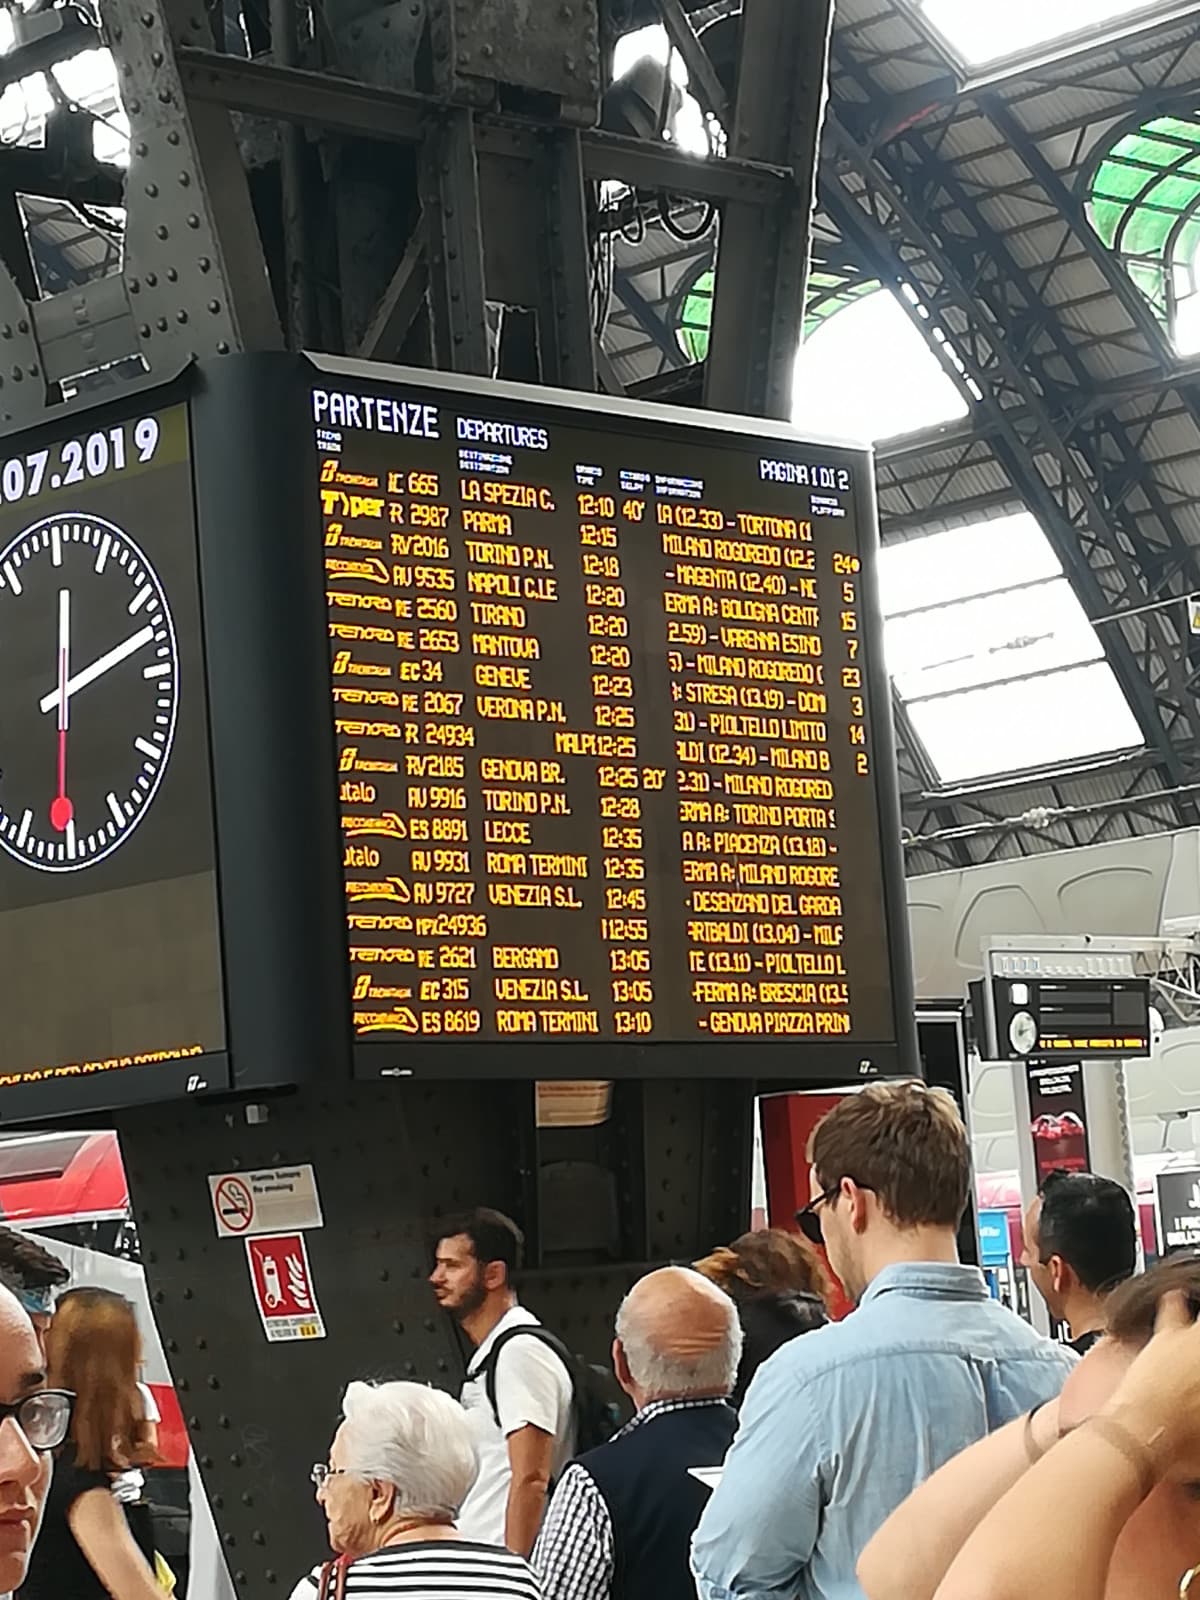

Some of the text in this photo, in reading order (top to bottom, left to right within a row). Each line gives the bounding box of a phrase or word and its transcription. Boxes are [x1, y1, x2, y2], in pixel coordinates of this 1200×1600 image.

[313, 390, 547, 449] PARTENZE DEPARTURES
[760, 460, 849, 489] PAGINA 1 DI 2
[408, 472, 438, 495] 665
[461, 480, 480, 501] LA
[483, 482, 537, 507] SPEZIA
[539, 489, 554, 510] C.
[578, 494, 614, 517] 12:10
[675, 506, 723, 530] (12.33)
[737, 514, 797, 539] TORTONA
[389, 503, 404, 523] R
[410, 504, 449, 527] 2987
[462, 510, 512, 535] PARMA
[580, 525, 616, 547] 12:15
[663, 534, 712, 558] MILANO
[714, 540, 781, 566] ROGOREDO
[465, 541, 520, 566] TORINO
[523, 547, 553, 569] P.N.
[583, 555, 619, 577] 12:18
[677, 564, 737, 590] MAGENTA
[740, 572, 786, 595] (12.40)
[844, 582, 854, 602] 5
[393, 565, 412, 587] AV
[415, 566, 454, 590] 9535
[468, 571, 521, 596] NAPOLI
[586, 584, 625, 607] 12:20
[720, 598, 780, 623] BOLOGNA
[841, 611, 856, 630] 15
[416, 598, 457, 621] 2560
[470, 602, 525, 628] TIRANO
[588, 615, 627, 636] 12:20
[721, 627, 780, 651] VARENNA
[782, 633, 821, 656] ESINO
[847, 640, 857, 659] 7
[419, 629, 459, 652] 2653
[472, 634, 539, 659] MANTOVA
[591, 644, 630, 667] 12:20
[697, 654, 746, 678] MILANO
[748, 658, 814, 684] ROGOREDO
[842, 668, 861, 687] 23
[475, 665, 531, 689] GENEVE
[592, 675, 632, 697] 12:23
[686, 683, 738, 706] STRESA
[740, 686, 784, 709] (13.19)
[852, 697, 863, 715] 3
[424, 691, 463, 715] 2067
[477, 696, 534, 720] VERONA
[537, 700, 566, 723] P.N.
[595, 705, 634, 727] 12:25
[709, 714, 779, 738] PIOLTELLO
[781, 719, 826, 741] LIMITO
[850, 725, 864, 744] 14
[405, 723, 419, 743] R
[425, 723, 474, 746] 24934
[595, 736, 636, 757] 12:25
[709, 744, 756, 766] (12.34)
[770, 747, 817, 769] MILANO
[857, 753, 868, 773] 2
[481, 759, 538, 782] GENOVA
[541, 762, 565, 783] BR.
[598, 766, 638, 788] 12:25
[725, 773, 772, 796] MILANO
[775, 776, 833, 799] ROGORED
[408, 787, 427, 808] AV
[429, 787, 466, 808] 9916
[482, 790, 537, 813] TORINO
[540, 793, 570, 814] P.N.
[601, 796, 640, 818] 12:28
[733, 804, 782, 825] TORINO
[784, 807, 827, 828] PORTA
[410, 819, 429, 839] ES
[432, 818, 468, 841] 8891
[485, 821, 531, 843] LECCE
[603, 827, 641, 848] 12:35
[714, 832, 781, 855] PIACENZA
[783, 835, 826, 856] (13.18)
[412, 851, 431, 872] AV
[434, 850, 469, 872] 9931
[487, 852, 526, 874] ROMA
[529, 854, 587, 877] TERMINI
[604, 858, 644, 879] 12:35
[739, 863, 787, 884] MILANO
[789, 866, 840, 887] ROGORE
[414, 883, 433, 904] AV
[436, 882, 474, 904] 9727
[488, 884, 551, 906] VENEZIA
[554, 886, 582, 907] S.L.
[606, 889, 646, 909] 12:45
[693, 888, 769, 914] DESENZANO
[771, 894, 797, 915] DEL
[799, 895, 841, 915] GARDA
[609, 919, 647, 940] 12:55
[753, 923, 800, 944] (13.04)
[439, 945, 476, 968] 2621
[493, 947, 558, 968] BERGAMO
[610, 950, 649, 971] 13:05
[765, 953, 834, 974] PIOLTELLO
[495, 979, 558, 1000] VENEZIA
[561, 980, 588, 1001] S.L.
[612, 980, 652, 1002] 13:05
[759, 983, 817, 1003] BRESCIA
[422, 1012, 441, 1033] ES
[444, 1010, 480, 1032] 8619
[496, 1010, 536, 1032] ROMA
[539, 1011, 598, 1032] TERMINI
[615, 1012, 651, 1033] 13:10
[710, 1012, 763, 1033] GENOVA
[764, 1012, 814, 1033] PIAZZA
